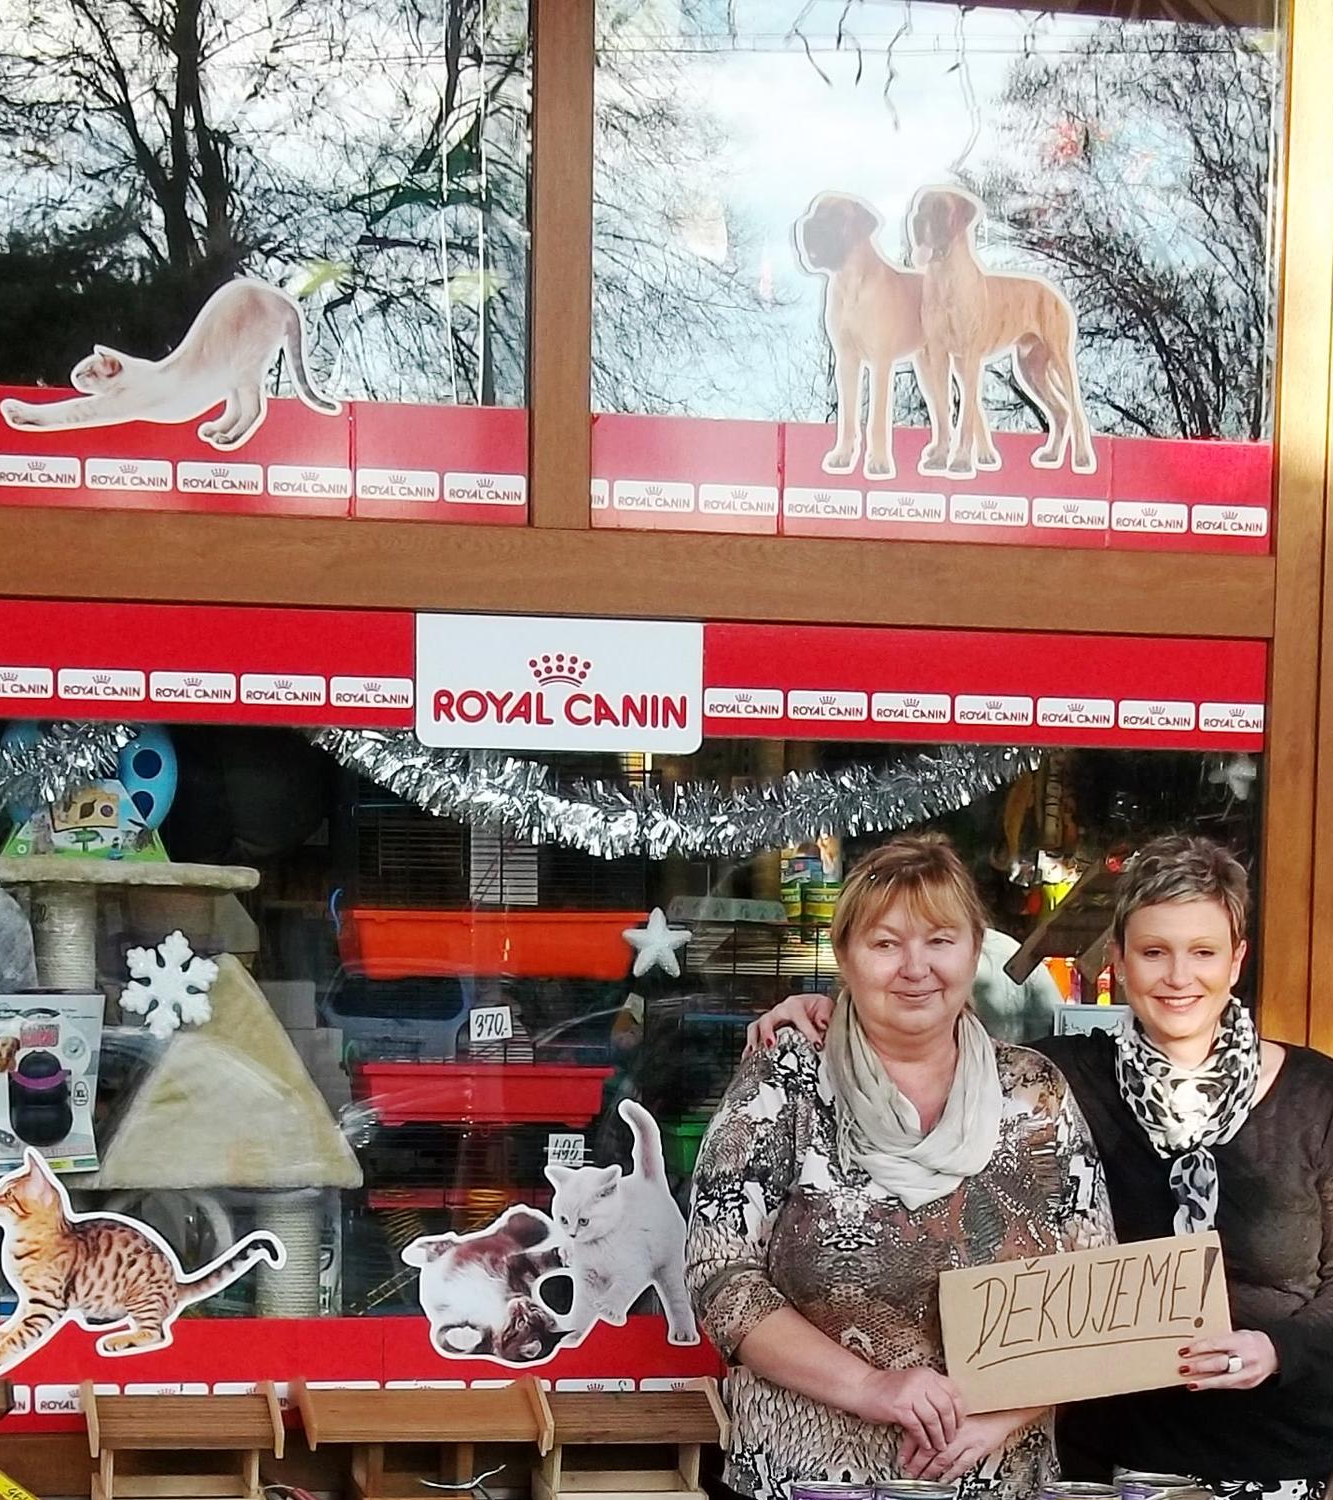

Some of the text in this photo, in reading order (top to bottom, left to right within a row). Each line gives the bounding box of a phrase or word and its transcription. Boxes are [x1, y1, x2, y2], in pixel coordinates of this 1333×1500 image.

[448, 487, 522, 502] ROYAL CANIN
[788, 502, 858, 516] ROYAL CANIN
[1037, 512, 1105, 527] ROYAL CANIN
[1116, 516, 1184, 530] ROYAL CANIN
[63, 683, 140, 698] ROYAL CANIN
[245, 688, 321, 703] ROYAL CANIN
[335, 691, 408, 706] ROYAL CANIN
[433, 690, 687, 728] ROYAL CANIN
[709, 702, 779, 716] ROYAL CANIN
[877, 707, 947, 721] ROYAL CANIN
[1042, 712, 1111, 726] ROYAL CANIN
[1123, 714, 1191, 728] ROYAL CANIN
[967, 1247, 1220, 1363] DĚKUJEME!
[39, 1399, 75, 1411] ROYAL
